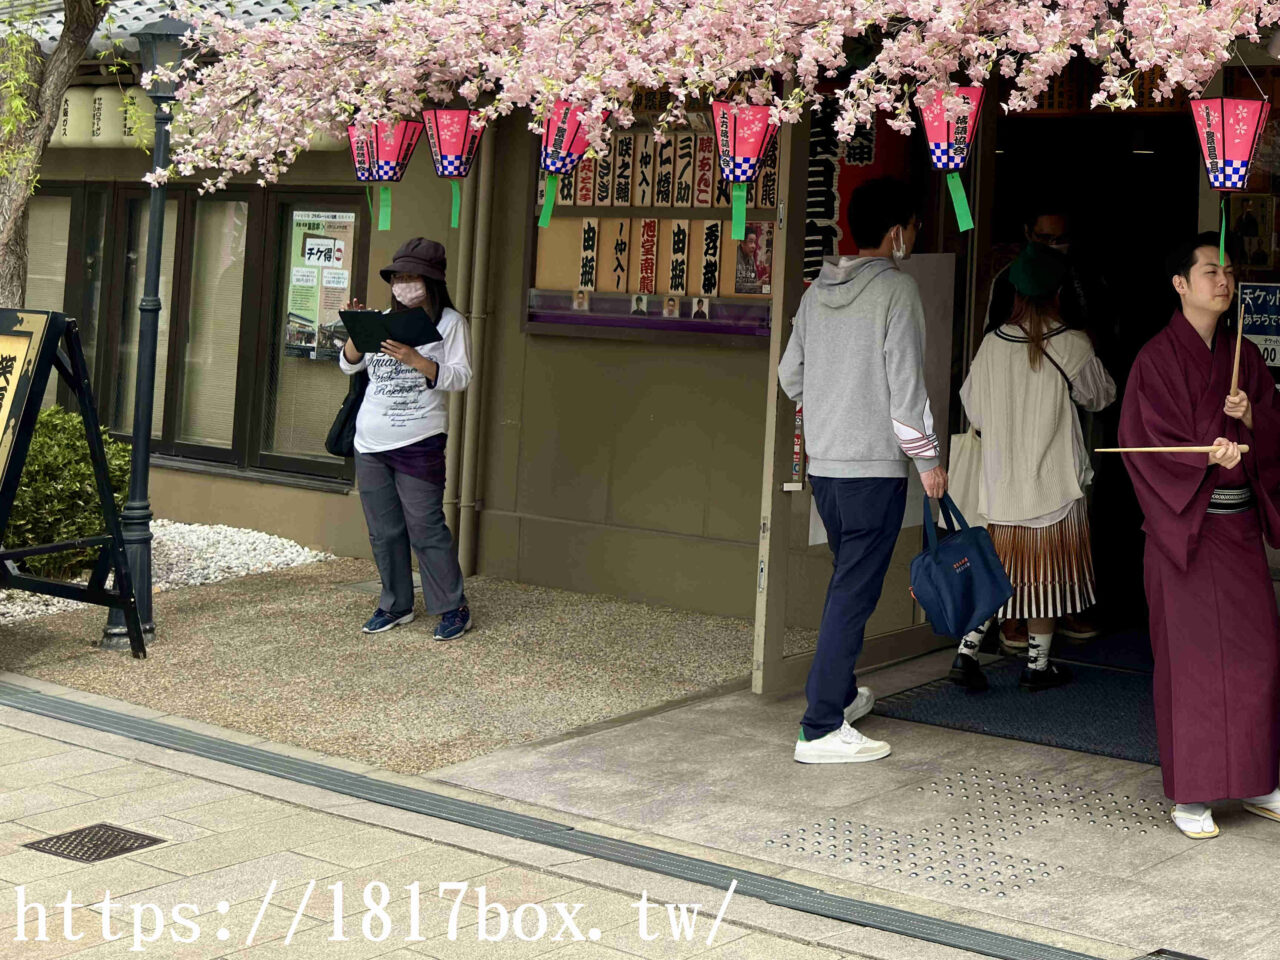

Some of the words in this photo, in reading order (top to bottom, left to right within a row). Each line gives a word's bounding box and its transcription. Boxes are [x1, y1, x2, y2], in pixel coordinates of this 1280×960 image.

[953, 95, 970, 157] 上落語協会
